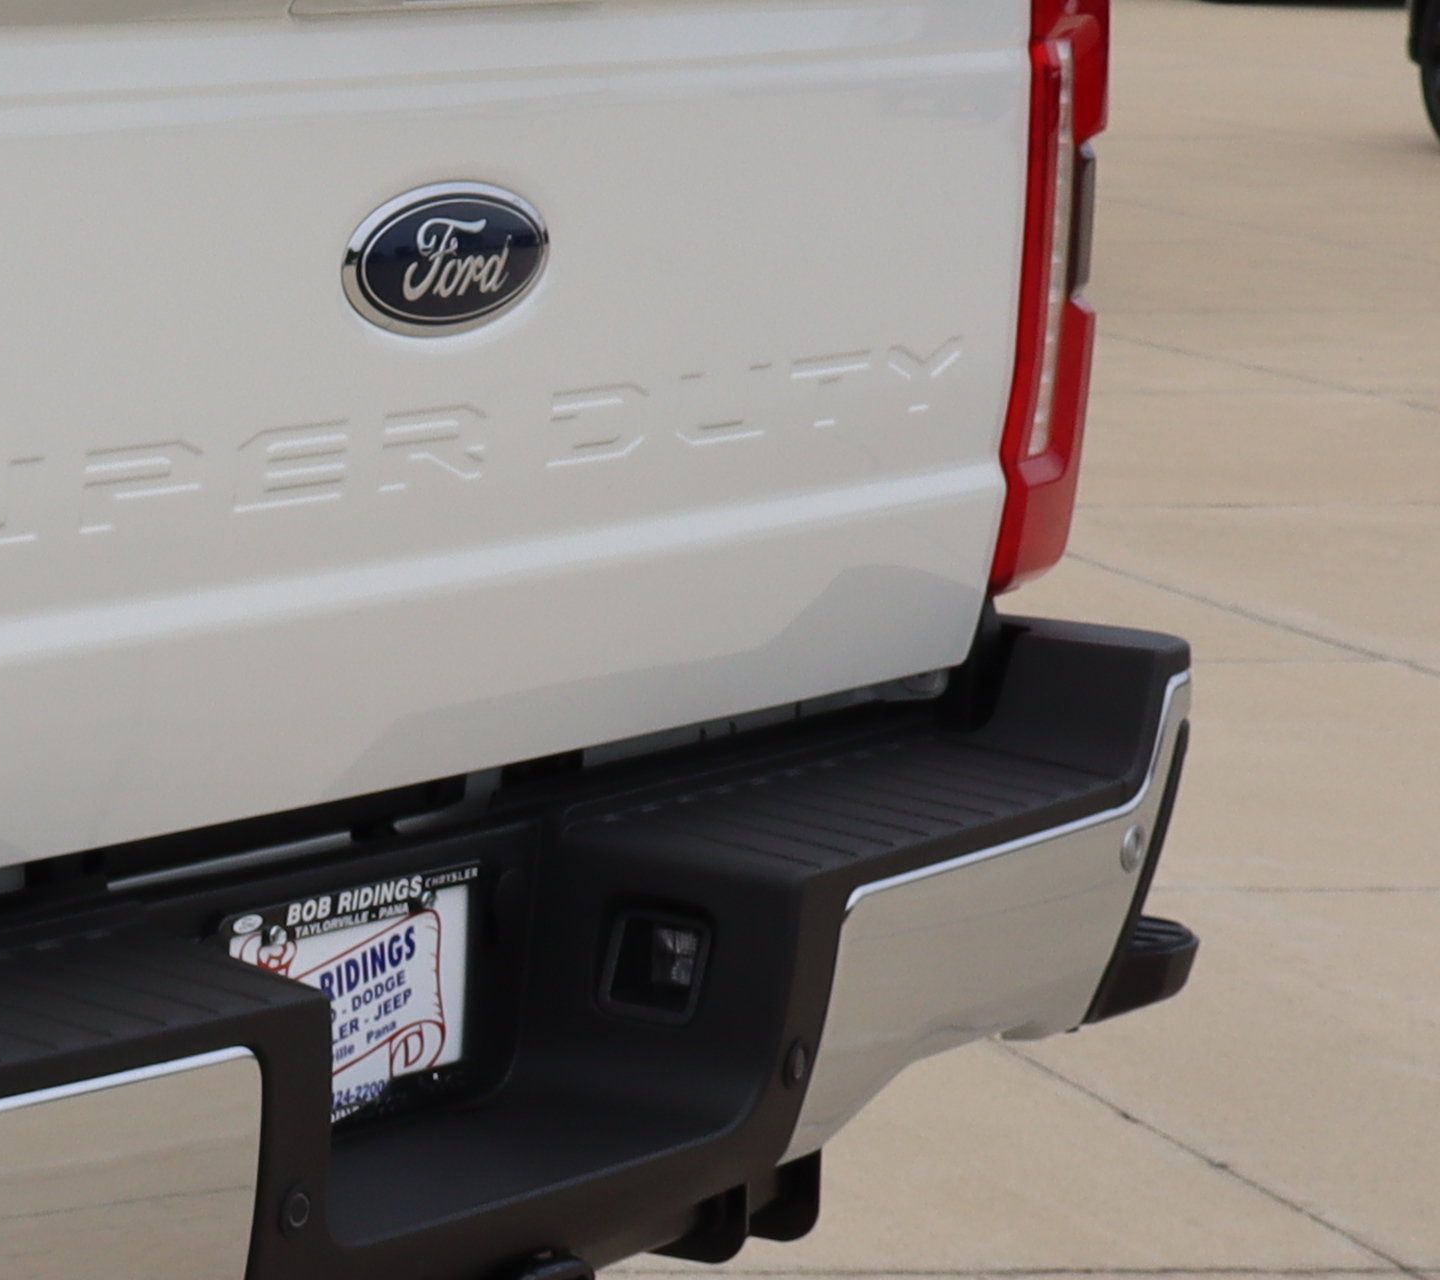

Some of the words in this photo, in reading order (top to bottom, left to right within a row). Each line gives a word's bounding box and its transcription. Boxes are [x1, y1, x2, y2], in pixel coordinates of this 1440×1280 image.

[402, 217, 512, 302] Ford
[546, 335, 964, 470] DUTY
[286, 895, 332, 927] BOB
[336, 875, 424, 915] RIDINGS
[424, 867, 479, 889] CHRYSLER
[294, 910, 369, 940] TAYLORVILLE
[378, 902, 410, 920] PANA
[319, 925, 416, 1002] RIDINGS
[351, 969, 407, 1012] DODGE
[373, 988, 413, 1021] JEEP
[366, 1021, 398, 1044] Pana
